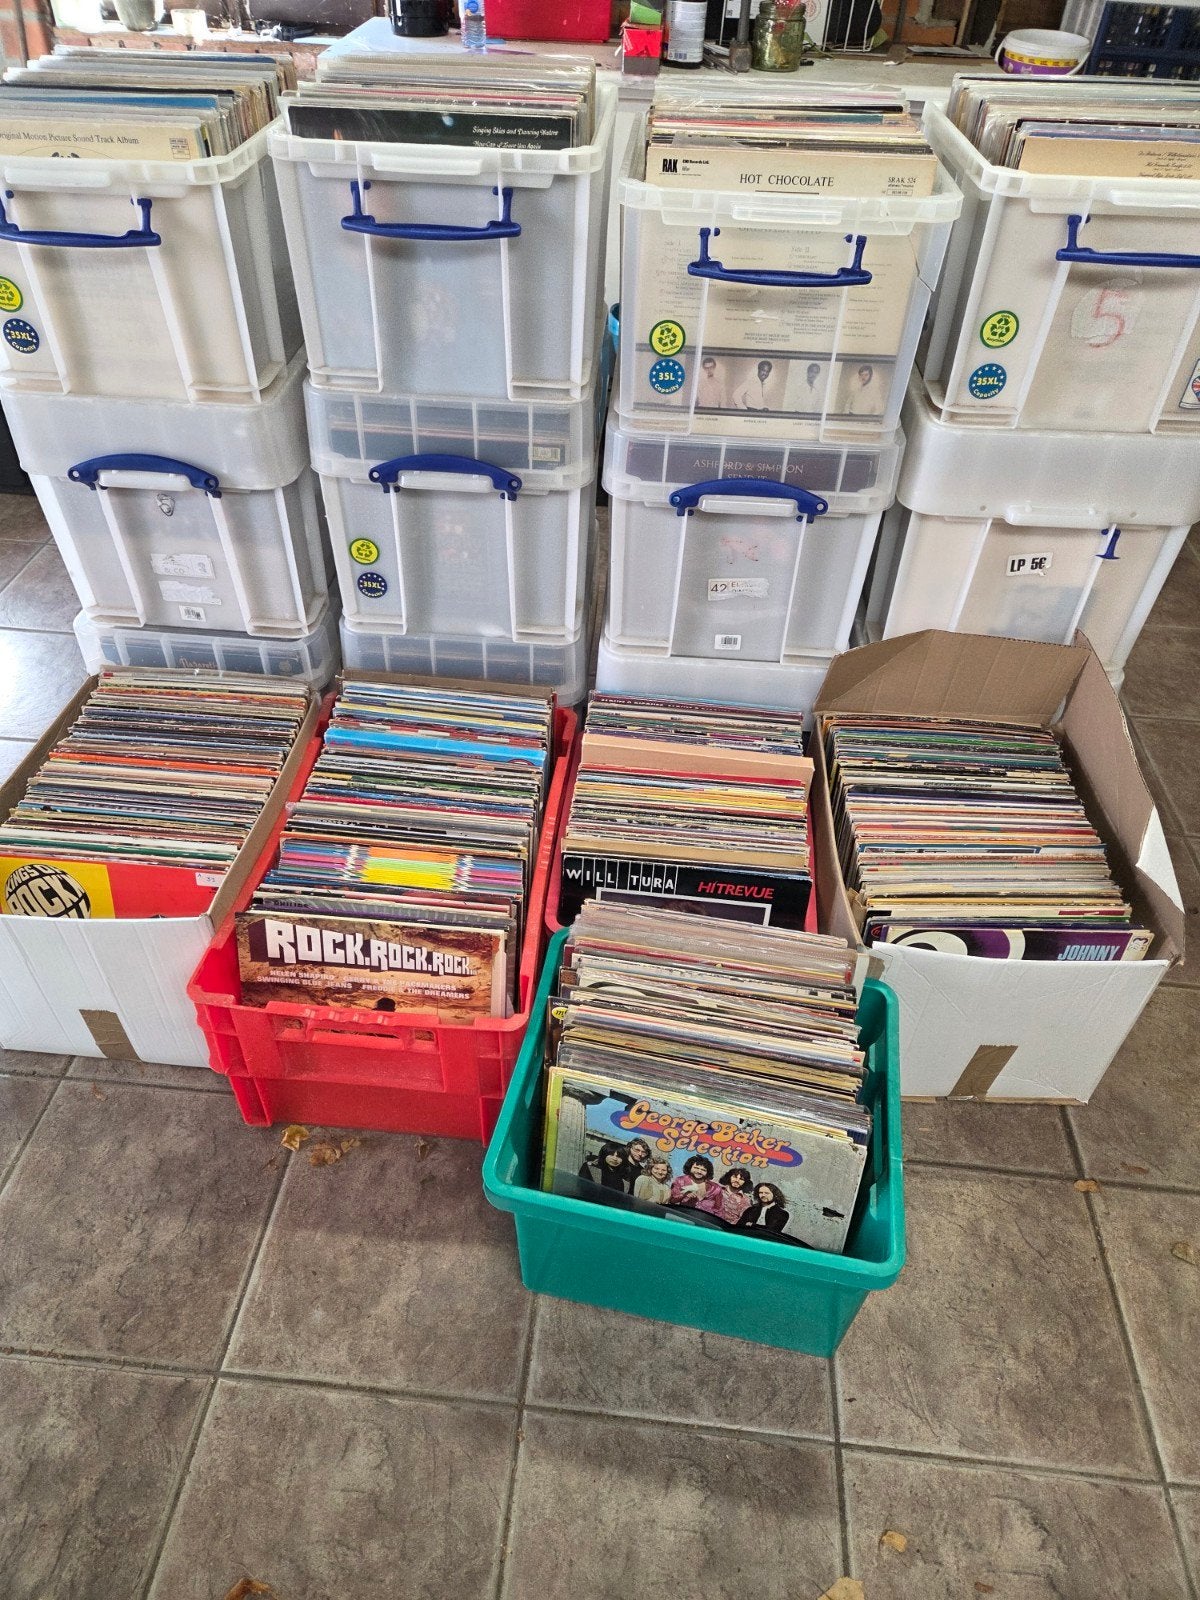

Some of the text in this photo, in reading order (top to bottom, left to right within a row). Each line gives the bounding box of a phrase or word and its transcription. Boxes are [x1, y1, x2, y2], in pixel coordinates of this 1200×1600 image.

[0, 132, 139, 144] riginal Motion Picture Sound Track Album
[662, 158, 678, 173] RAK
[740, 173, 834, 187] HOT CHOCOLATE
[1088, 286, 1127, 348] 5
[10, 330, 33, 341] 35XL
[658, 372, 675, 381] 35L
[976, 377, 999, 386] 35XL
[655, 383, 679, 393] Capacity
[973, 388, 999, 398] Capacity
[745, 462, 754, 471] &
[757, 463, 803, 474] SIMPON
[1010, 559, 1026, 572] LP
[363, 581, 381, 589] 35XL
[710, 583, 728, 592] 42
[6, 865, 39, 899] KINGS
[566, 869, 674, 890] WILL TURA
[1057, 945, 1120, 960] JOHNNY
[257, 975, 301, 985] SWINGING
[302, 979, 323, 987] BLUE
[326, 981, 352, 989] JEANS
[424, 989, 470, 999] DREAMERS
[270, 970, 295, 978] HELEN
[299, 972, 335, 980] SHAPIRO
[398, 980, 456, 991] PACEMAKERS
[620, 1100, 791, 1153] George Baker
[656, 1127, 769, 1168] Selection
